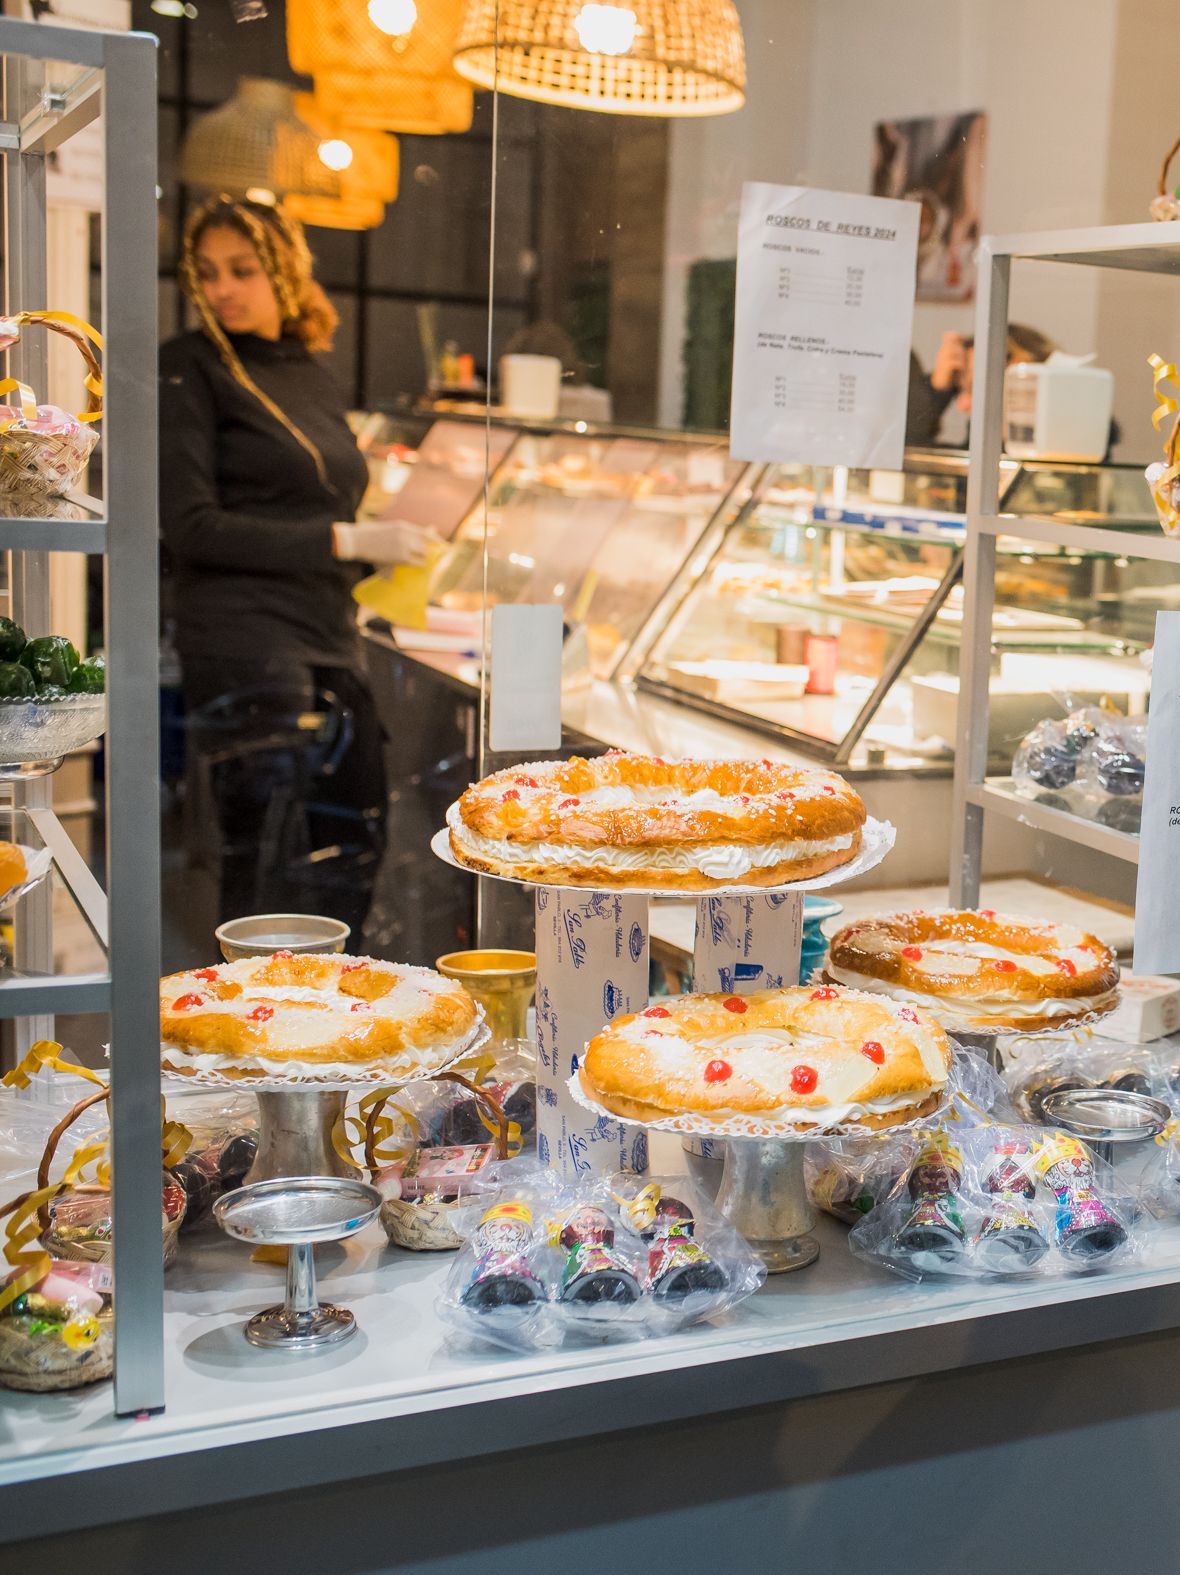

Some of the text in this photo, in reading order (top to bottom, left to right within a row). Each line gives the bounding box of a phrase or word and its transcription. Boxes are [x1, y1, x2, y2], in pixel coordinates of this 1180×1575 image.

[766, 215, 811, 227] ROSCOS
[817, 220, 832, 231] DE
[837, 223, 871, 236] REYES
[1169, 818, 1180, 826] (de
[567, 909, 586, 969] San Pablo
[572, 1134, 588, 1157] San
